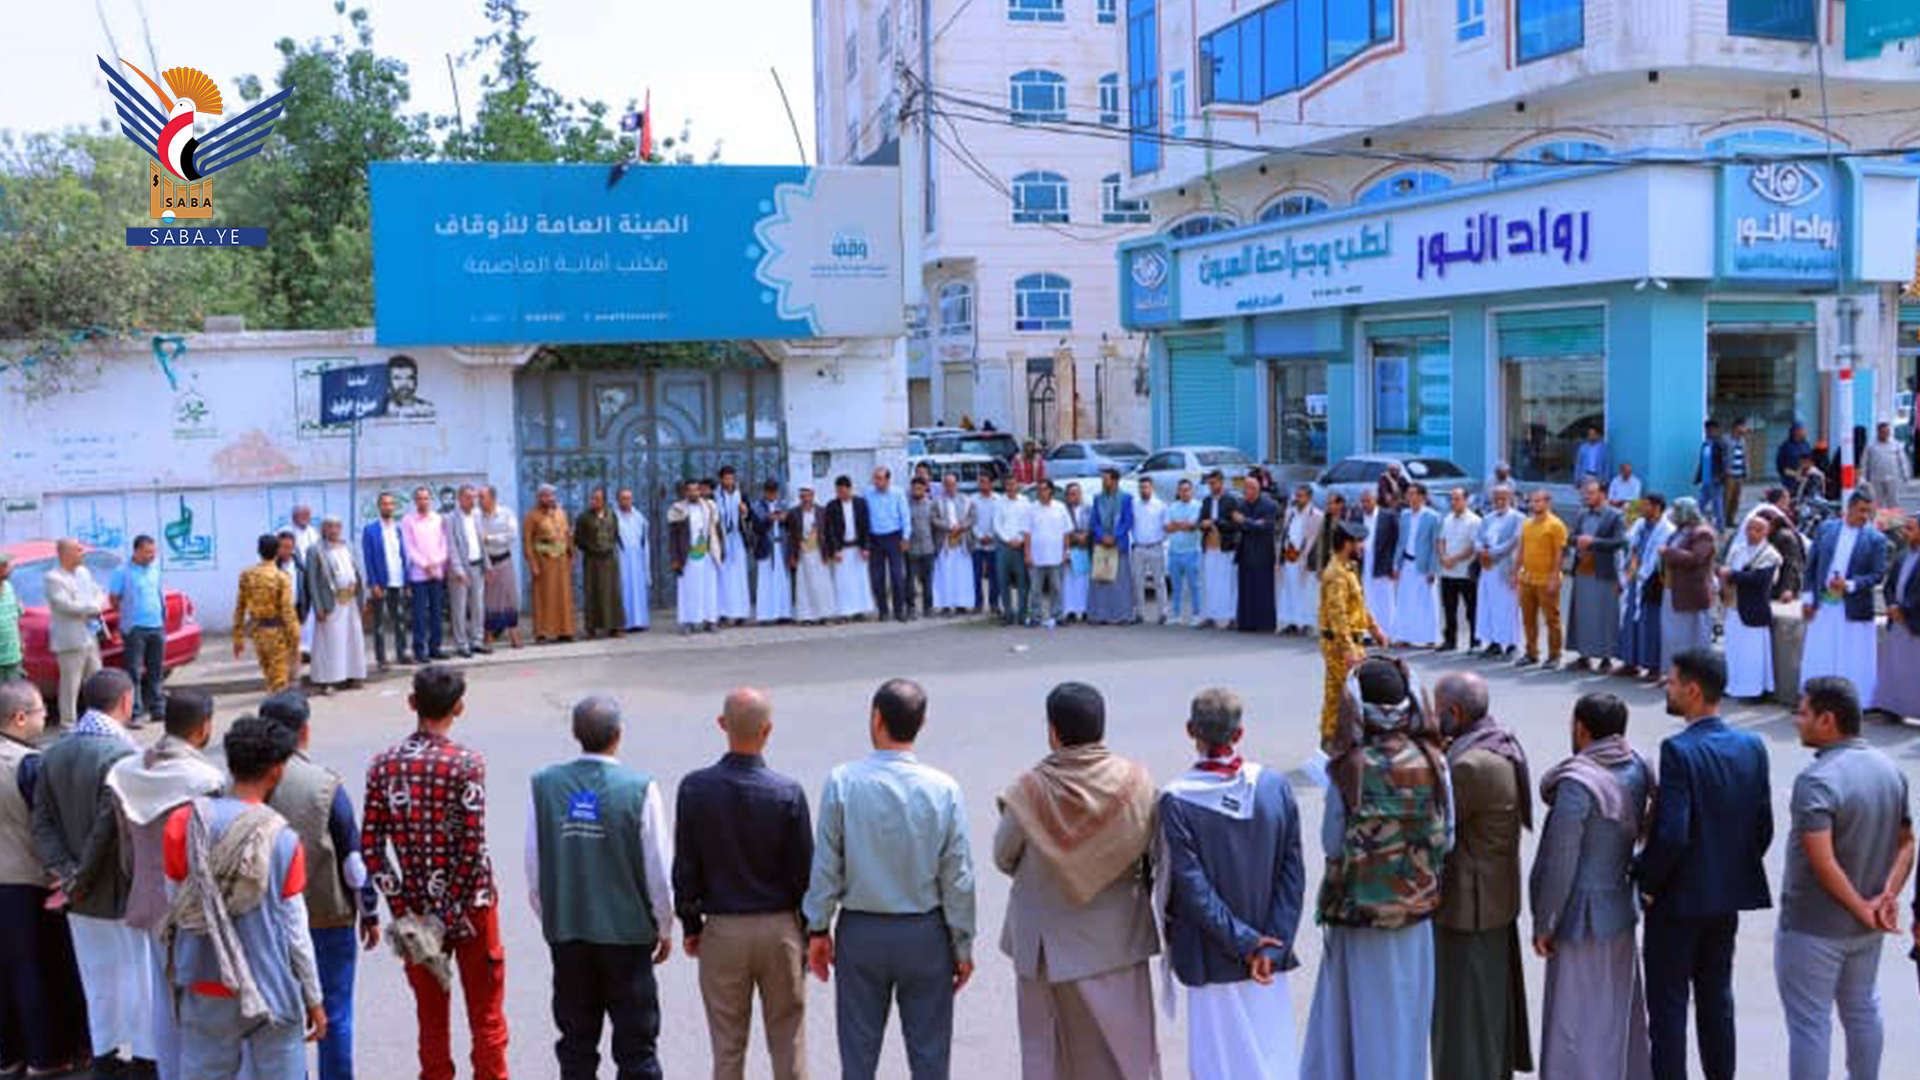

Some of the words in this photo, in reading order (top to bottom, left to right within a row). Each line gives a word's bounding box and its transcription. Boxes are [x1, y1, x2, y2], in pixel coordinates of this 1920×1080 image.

[434, 211, 529, 239] للأوقاف
[536, 213, 611, 235] العامة
[618, 213, 689, 239] الهيئة
[1506, 207, 1589, 263] رواد
[1736, 213, 1792, 247] النور
[1794, 213, 1839, 250] رواد
[1256, 237, 1332, 278] وجراحة
[1334, 216, 1392, 269] لطب
[1417, 212, 1499, 280] النور
[463, 249, 549, 274] العاصمة
[617, 251, 668, 274] مكتب
[1199, 244, 1251, 287] العيون
